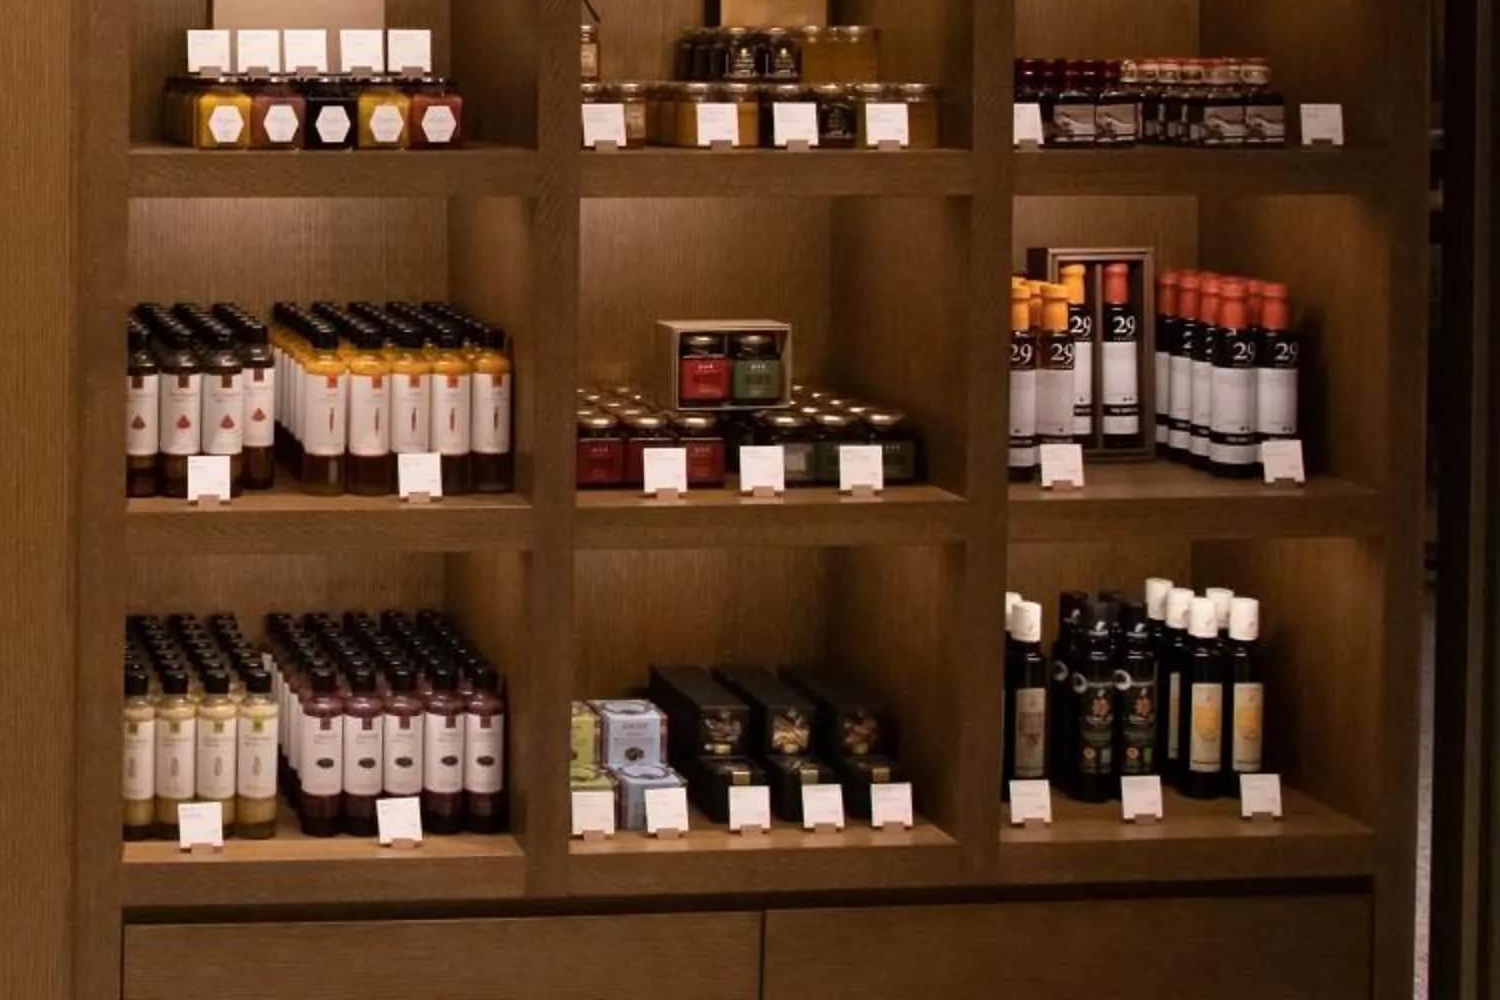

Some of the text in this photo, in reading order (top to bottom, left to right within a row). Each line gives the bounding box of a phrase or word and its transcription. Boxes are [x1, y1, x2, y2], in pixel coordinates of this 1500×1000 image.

[1070, 315, 1092, 336] 29
[1112, 315, 1136, 336] 29
[1011, 343, 1033, 365] 29
[1051, 343, 1073, 365] 29
[1232, 341, 1256, 362] 29
[1274, 341, 1298, 364] 29
